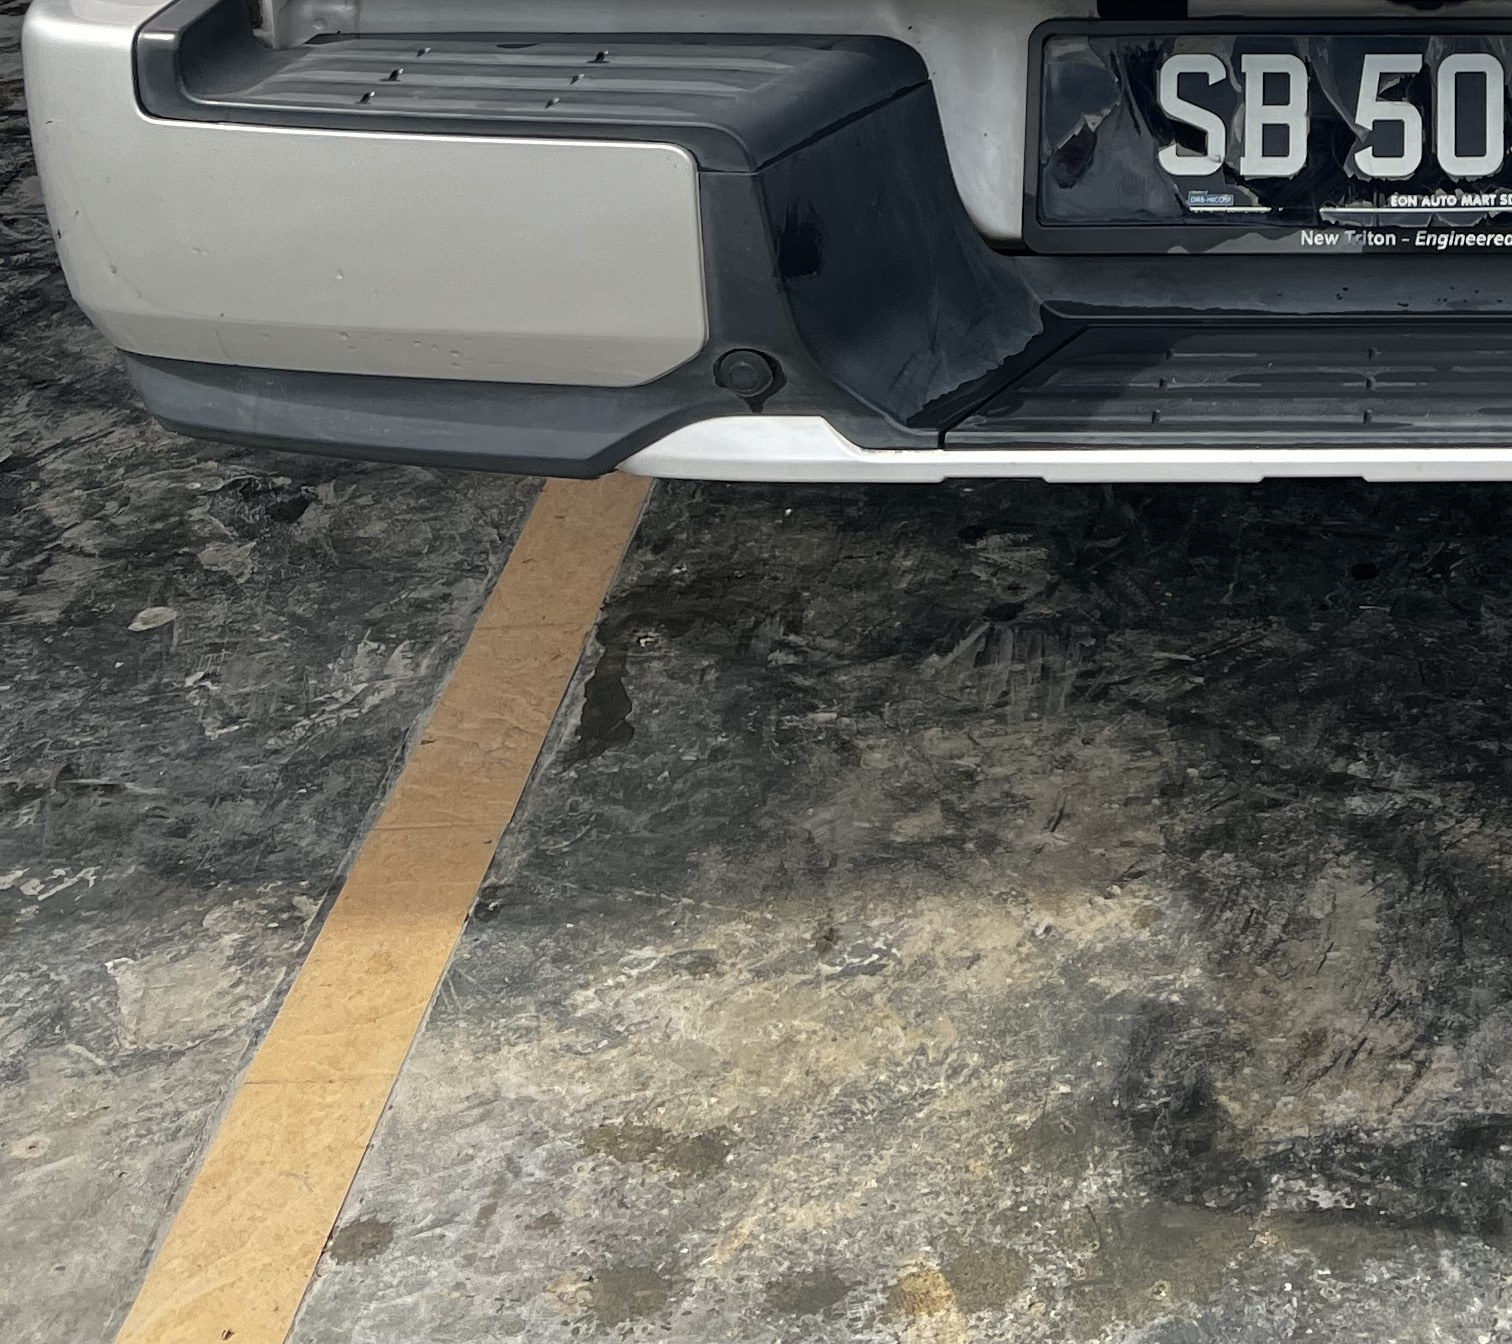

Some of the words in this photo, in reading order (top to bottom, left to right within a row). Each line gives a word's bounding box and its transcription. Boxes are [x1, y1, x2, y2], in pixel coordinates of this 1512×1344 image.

[1156, 50, 1311, 179] SB
[1391, 194, 1417, 207] EON
[1421, 194, 1458, 207] AUTO
[1461, 193, 1497, 207] MART
[1300, 229, 1339, 246] New
[1344, 229, 1397, 247] Triton
